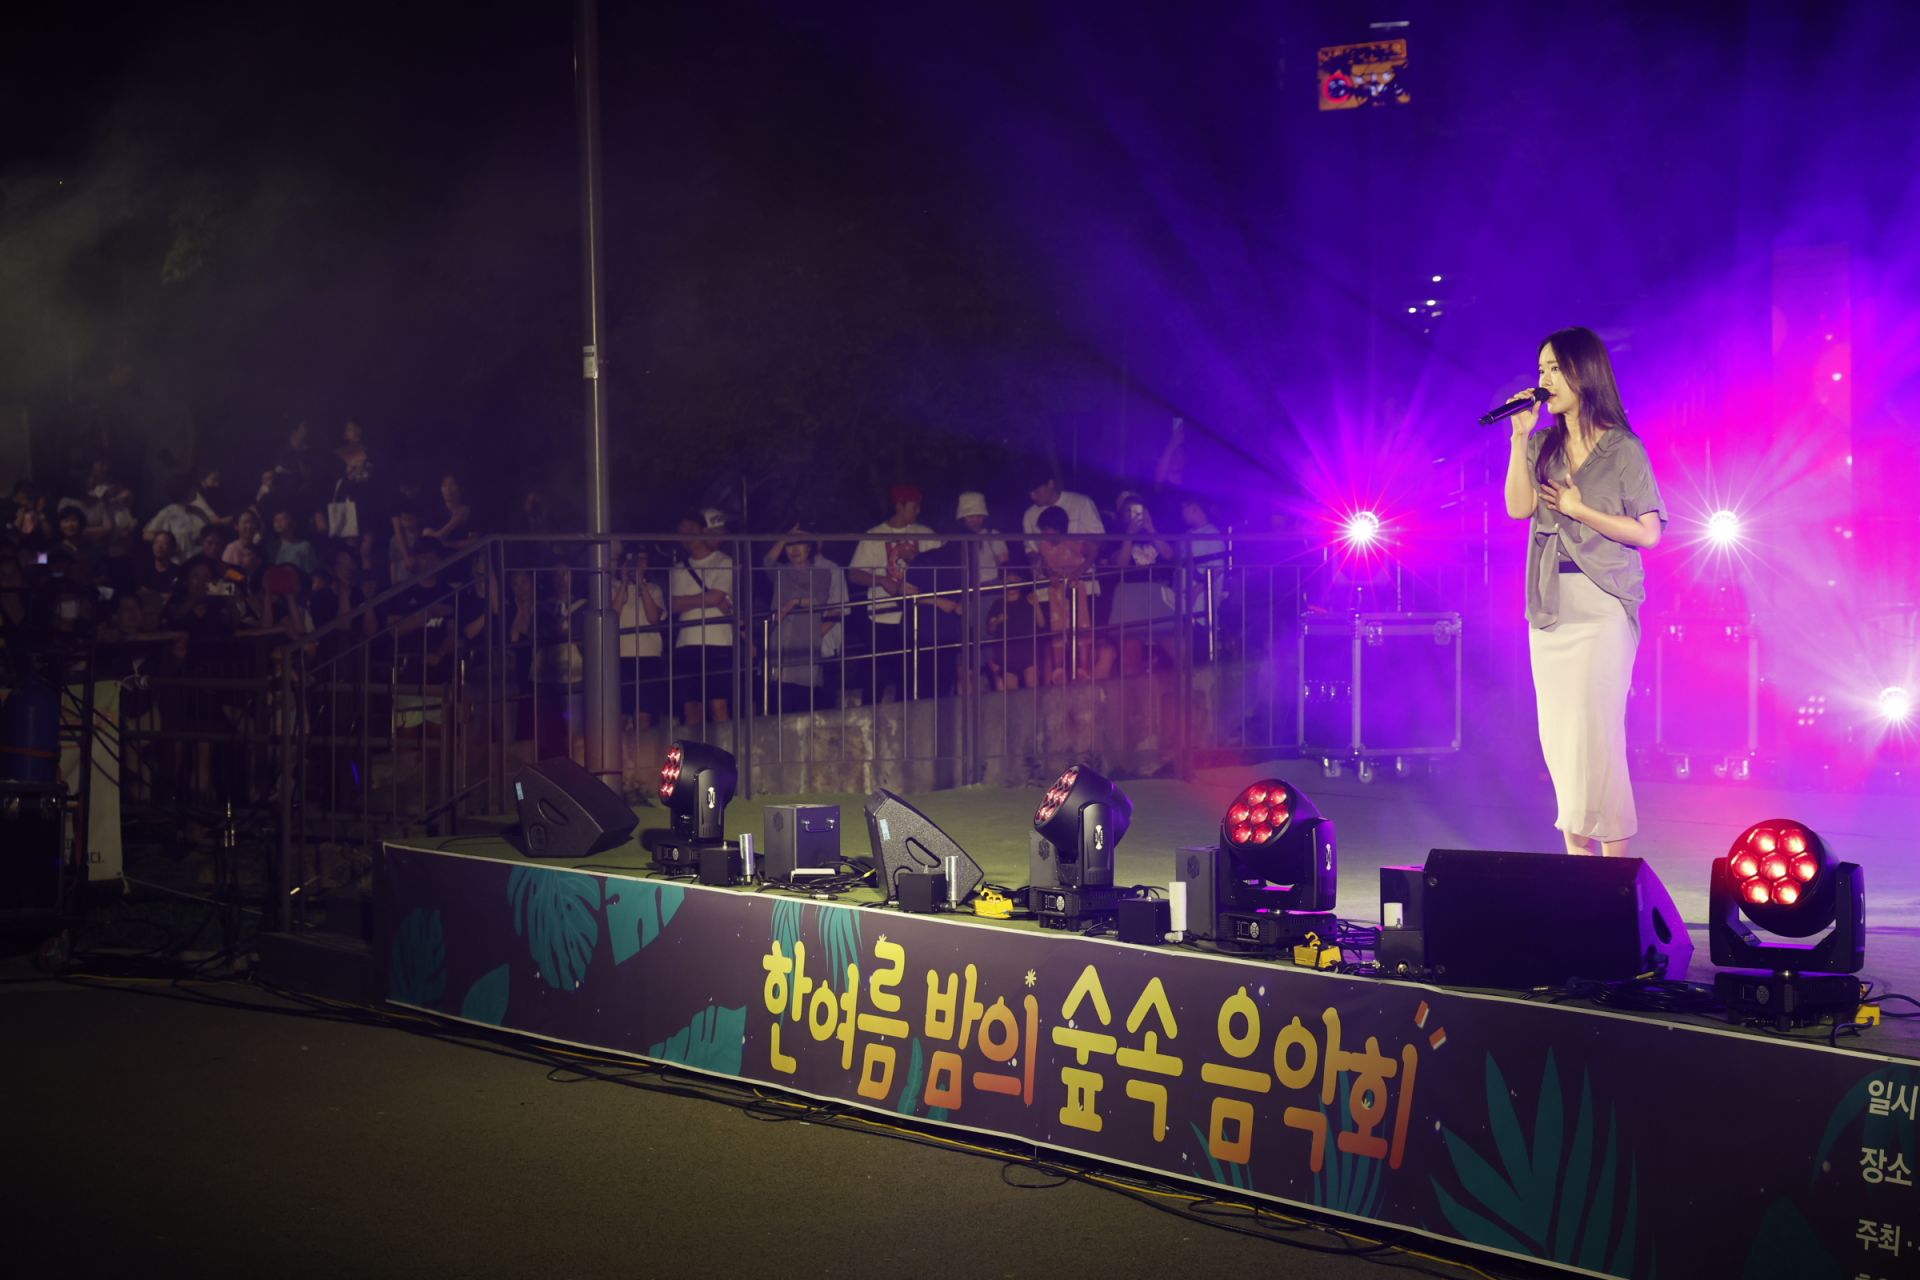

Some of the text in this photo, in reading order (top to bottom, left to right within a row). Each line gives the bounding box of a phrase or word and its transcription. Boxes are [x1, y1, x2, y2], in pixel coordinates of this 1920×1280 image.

[762, 938, 1418, 1173] 한여름 밤의 숲속 음악회
[1867, 1079, 1919, 1121] 일시
[1859, 1146, 1913, 1187] 장소
